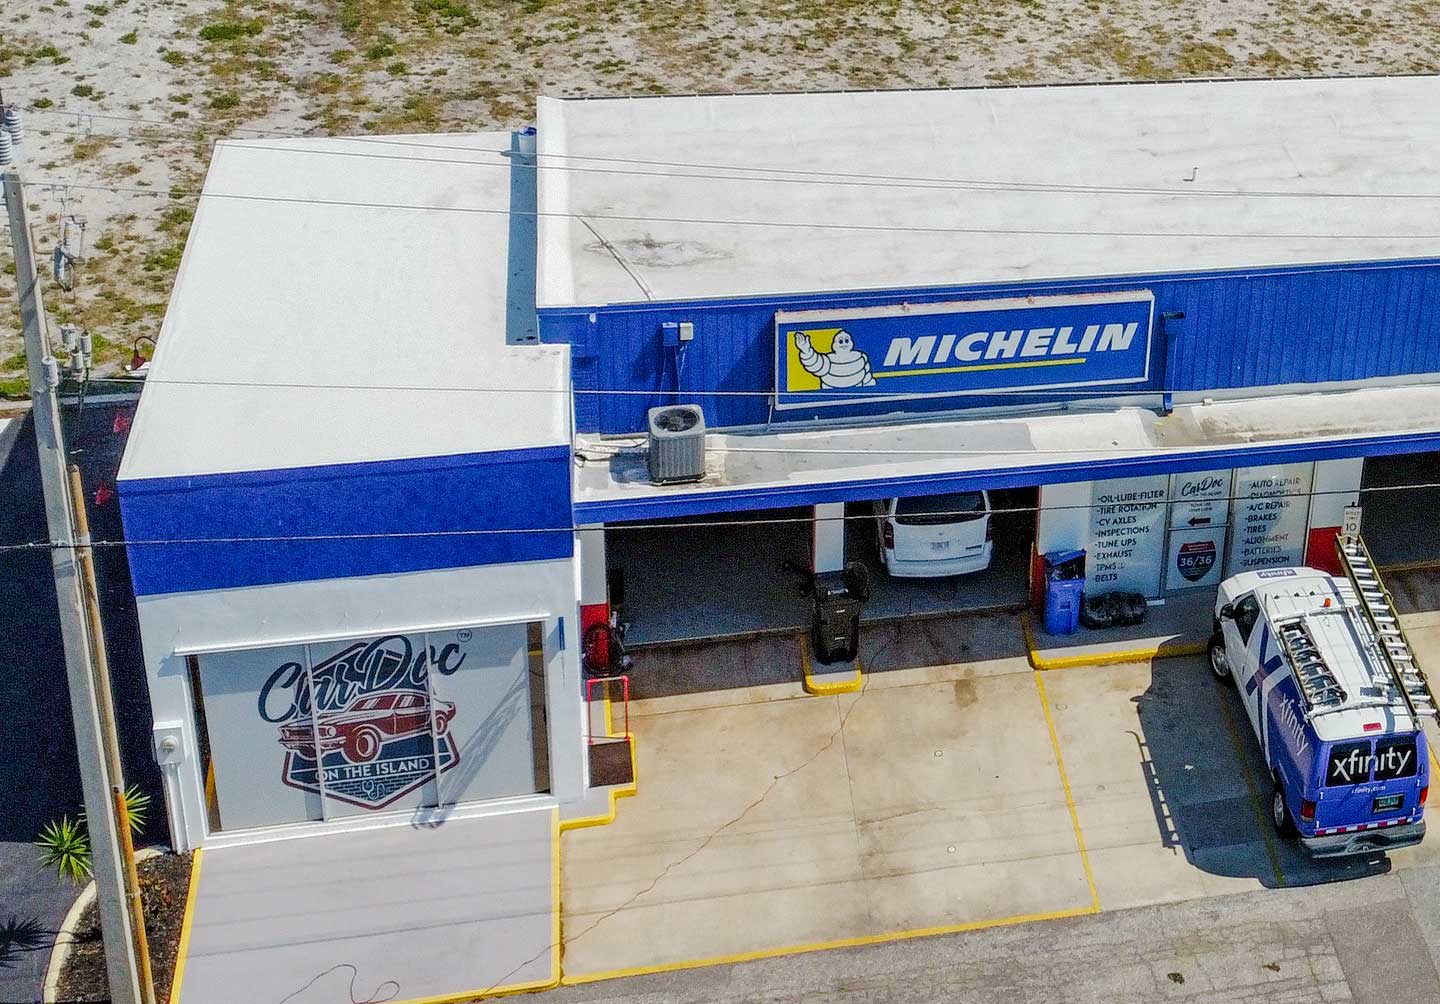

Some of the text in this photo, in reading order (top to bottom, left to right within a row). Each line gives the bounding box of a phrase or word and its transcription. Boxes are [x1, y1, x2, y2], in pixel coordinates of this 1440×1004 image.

[883, 322, 1139, 367] MICHELIN
[1275, 478, 1300, 487] REPAIR
[1119, 503, 1157, 513] ROTATION
[1265, 501, 1290, 510] REPAIR
[1112, 515, 1137, 525] AXLES
[1346, 523, 1357, 531] 10
[1120, 538, 1137, 546] UPS
[1180, 555, 1212, 567] 36/36
[1333, 747, 1412, 781] xfinity
[315, 757, 430, 782] ON THE ISLAND
